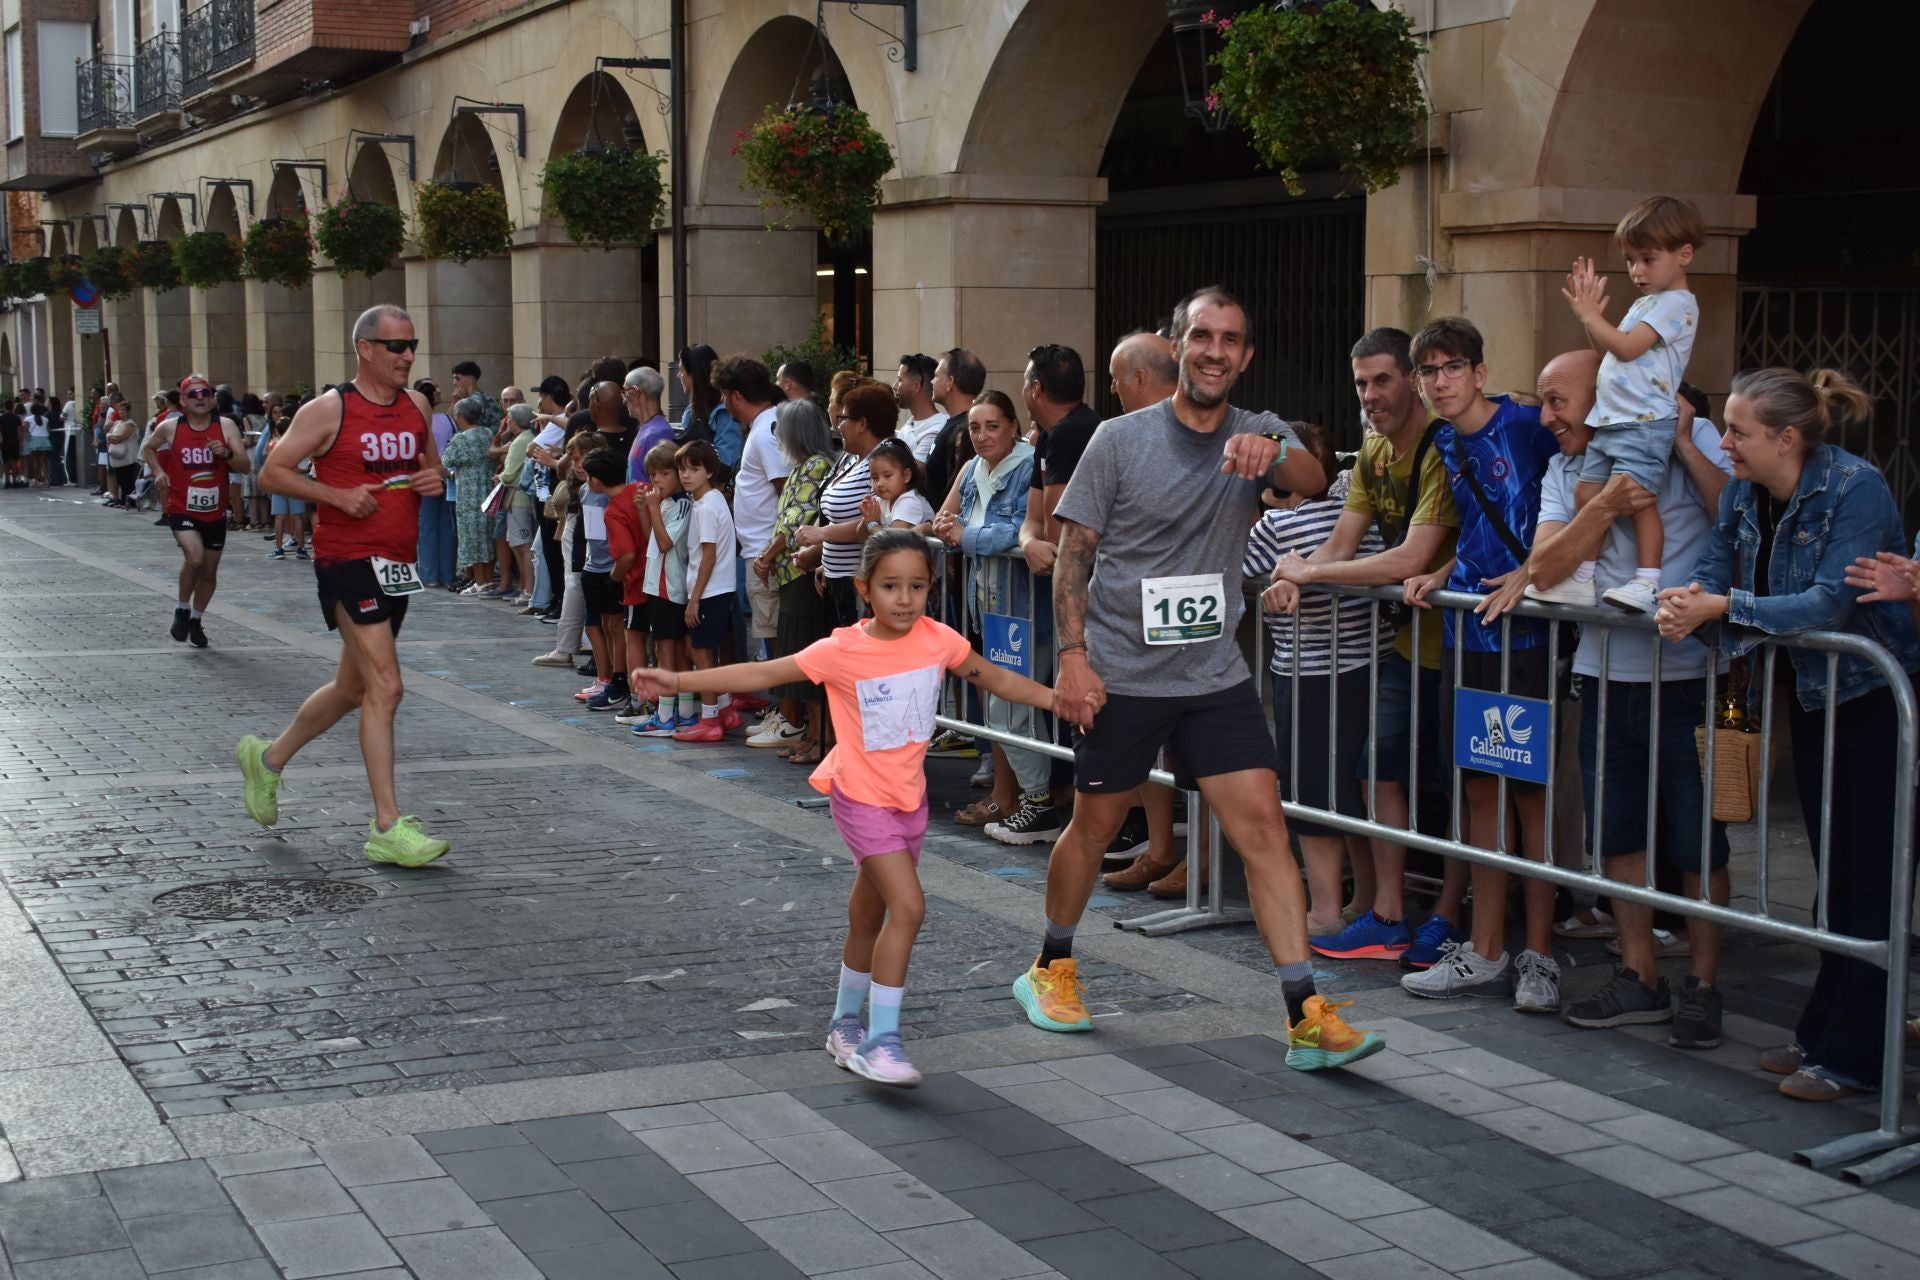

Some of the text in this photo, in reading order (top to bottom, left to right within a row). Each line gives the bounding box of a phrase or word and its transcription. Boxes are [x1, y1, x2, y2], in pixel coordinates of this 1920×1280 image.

[181, 447, 214, 465] 360
[360, 431, 416, 462] 360
[192, 495, 216, 506] 161
[380, 563, 412, 584] 159
[1154, 595, 1217, 625] 162
[990, 647, 1022, 667] Calahorra
[1470, 735, 1532, 765] Calahorra
